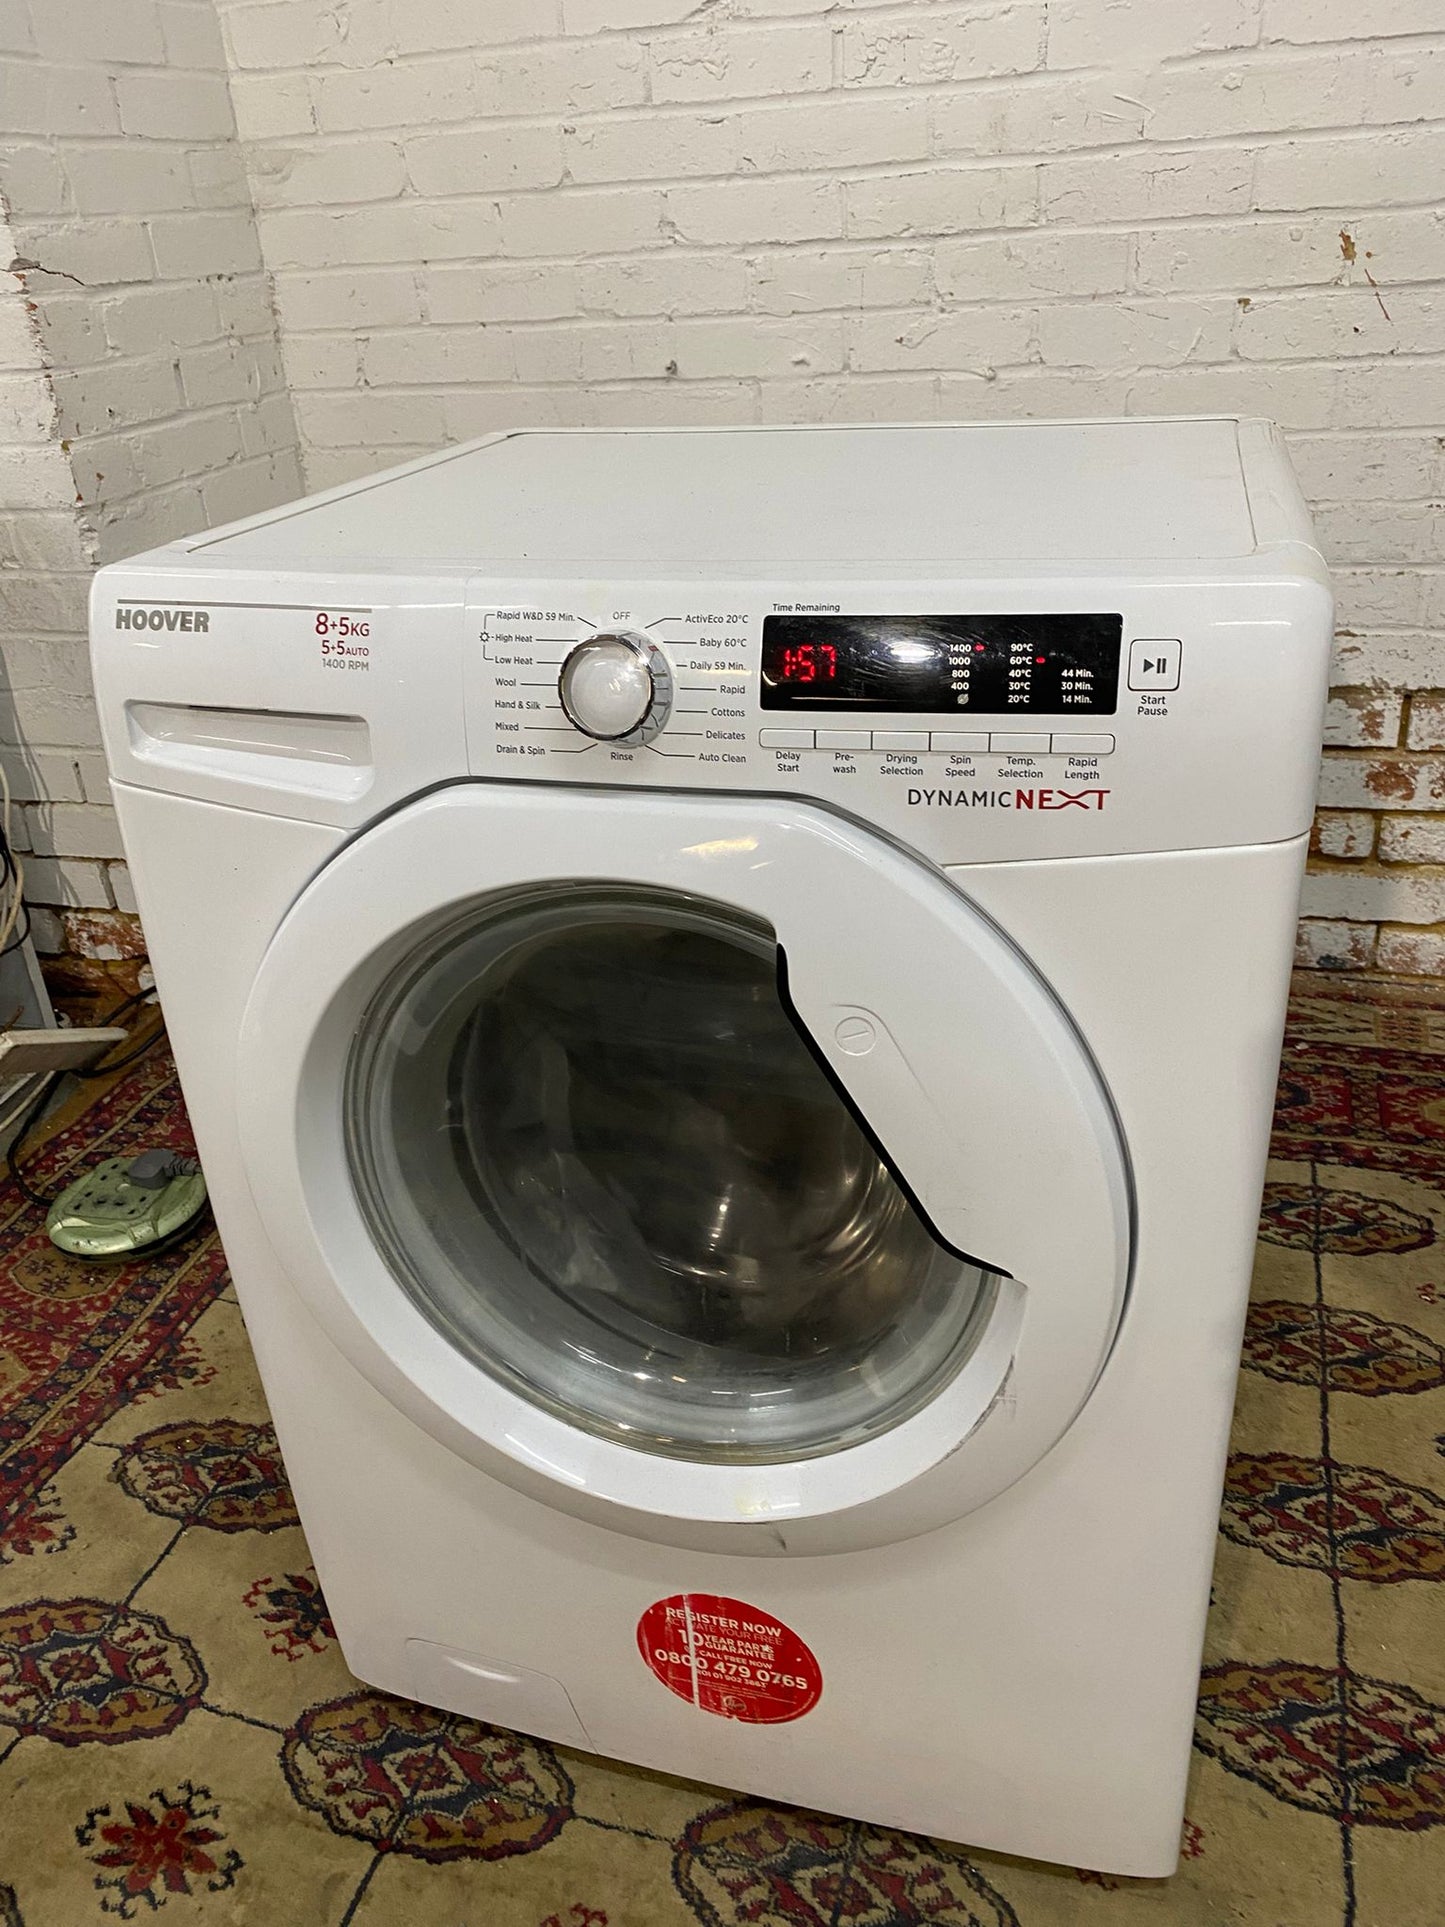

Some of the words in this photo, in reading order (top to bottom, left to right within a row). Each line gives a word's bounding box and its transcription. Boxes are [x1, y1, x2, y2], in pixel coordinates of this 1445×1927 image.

[772, 603, 793, 612] Time
[795, 604, 840, 612] Remaining
[116, 608, 210, 632] HOOVER
[496, 610, 520, 621] Rapid
[522, 612, 544, 620] W&D
[558, 612, 576, 622] Min.
[612, 611, 631, 620] OFF
[684, 614, 724, 624] ActivEco
[726, 614, 749, 624] 20°C
[315, 612, 370, 636] 8+5KG
[495, 634, 514, 644] High
[514, 634, 533, 643] Heat
[700, 638, 722, 648] Baby
[724, 638, 748, 648] 60°C
[321, 640, 370, 657] 5+5AUTO
[950, 644, 972, 653] 1400
[1010, 643, 1034, 652] 90°C
[322, 658, 346, 670] 1400
[348, 660, 370, 671] RPM
[494, 656, 512, 665] Low
[514, 656, 533, 666] Heat
[783, 644, 837, 682] 1:57
[948, 656, 971, 666] 1000
[1009, 656, 1032, 665] 60°C
[690, 661, 712, 672] Daily
[728, 662, 746, 671] Min.
[952, 670, 970, 678] 800
[1008, 669, 1032, 678] 40°C
[1061, 669, 1074, 678] 44
[1075, 669, 1094, 678] Min.
[494, 678, 516, 686] Wool
[950, 682, 970, 690] 400
[1008, 682, 1031, 690] 30°C
[1060, 682, 1074, 690] 30
[1074, 682, 1094, 691] Min.
[720, 684, 746, 695] Rapid
[1008, 694, 1030, 704] 20°C
[1062, 694, 1072, 704] 14
[1074, 694, 1092, 704] Min.
[1140, 694, 1166, 705] Start
[494, 700, 516, 709] Hand
[518, 700, 524, 709] &
[526, 701, 541, 710] Silk
[711, 708, 746, 718] Cottons
[1137, 706, 1168, 716] Pause
[495, 722, 519, 731] Mixed
[706, 730, 746, 741] Delicates
[496, 744, 518, 754] Drain
[520, 746, 526, 754] &
[527, 746, 546, 756] Spin
[610, 752, 634, 761] Rinse
[698, 752, 720, 762] Auto
[722, 754, 746, 764] Clean
[775, 750, 801, 762] Delay
[834, 752, 854, 762] Pre-
[886, 754, 918, 764] Drying
[950, 755, 972, 765] Spin
[1006, 756, 1036, 767] Temp.
[1068, 757, 1098, 768] Rapid
[777, 763, 800, 772] Start
[832, 764, 857, 774] wash
[880, 766, 924, 776] Selection
[945, 768, 976, 778] Speed
[998, 768, 1044, 779] Selection
[1064, 770, 1100, 781] Length
[718, 1626, 752, 1640] YOUR
[742, 1620, 782, 1638] NOW
[678, 1629, 704, 1647] 10
[704, 1633, 736, 1648] YEAR
[704, 1641, 776, 1662] GUARANTEE
[698, 1650, 723, 1660] CALL
[748, 1660, 773, 1670] NOW
[654, 1648, 708, 1670] 0800
[714, 1661, 752, 1678] 479
[756, 1670, 808, 1690] 0765
